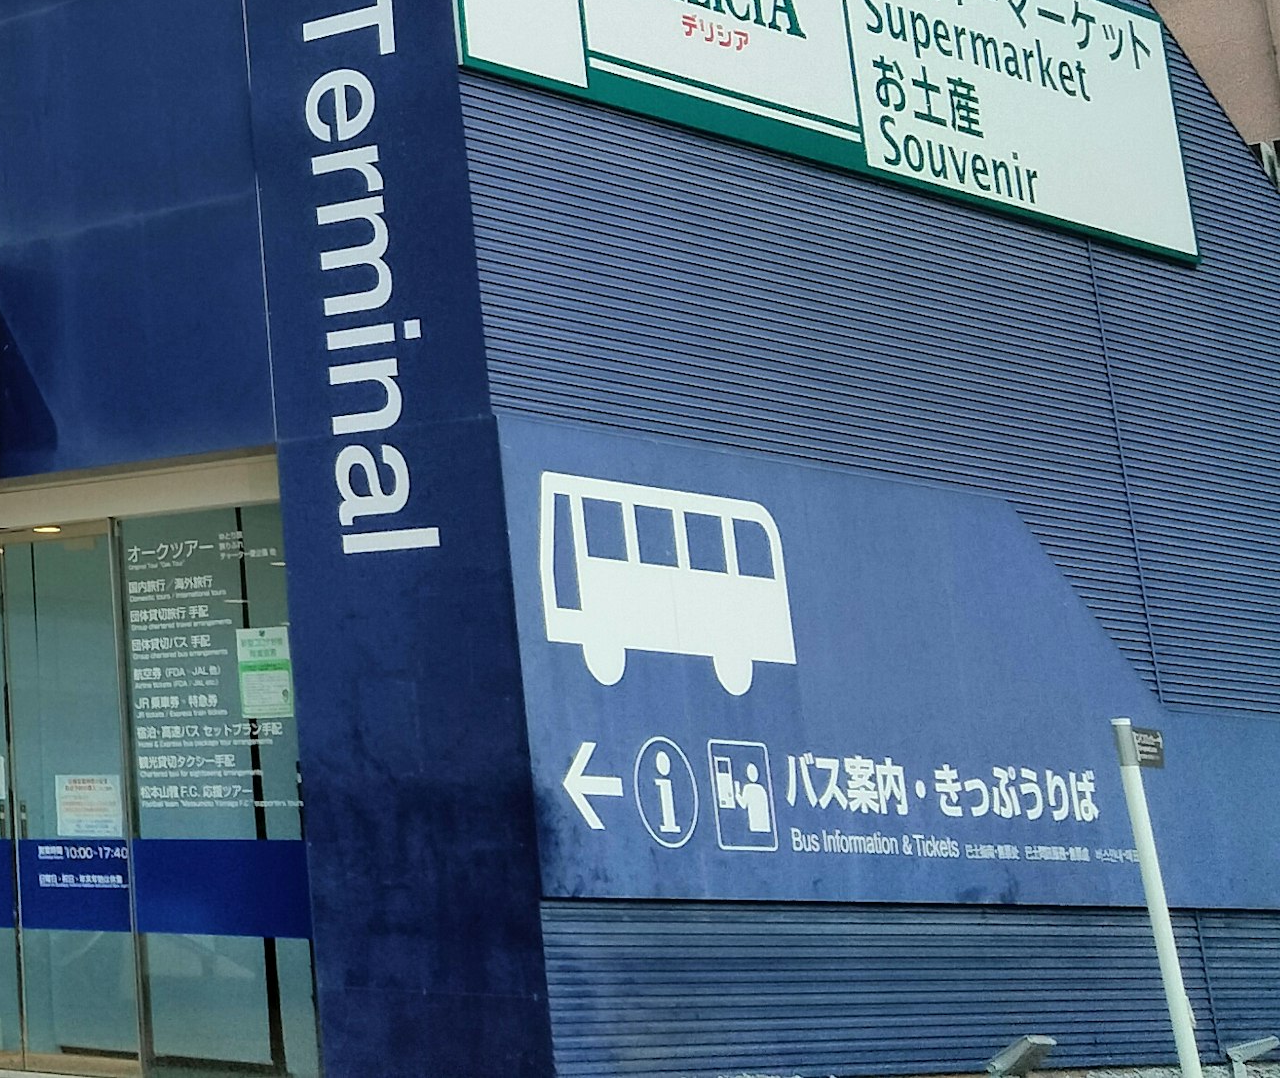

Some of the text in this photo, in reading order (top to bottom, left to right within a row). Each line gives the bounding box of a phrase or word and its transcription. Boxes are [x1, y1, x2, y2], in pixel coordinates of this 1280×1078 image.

[681, 14, 750, 51] デリシア
[872, 55, 984, 139] お土産
[881, 122, 1039, 205] Souvenir
[127, 540, 214, 563] オークツアー
[130, 605, 209, 623] 団体貸切旅行 手配
[132, 635, 211, 652] 団体貸切バス 手配
[139, 754, 236, 769] 観光貸切タクシー手配
[203, 785, 253, 799] 応援ツアー
[786, 752, 1099, 822] バス案内・きっぷうりば
[791, 827, 820, 852] Bus
[823, 829, 899, 855] Information
[902, 834, 913, 854] &
[913, 834, 961, 859] Tickets
